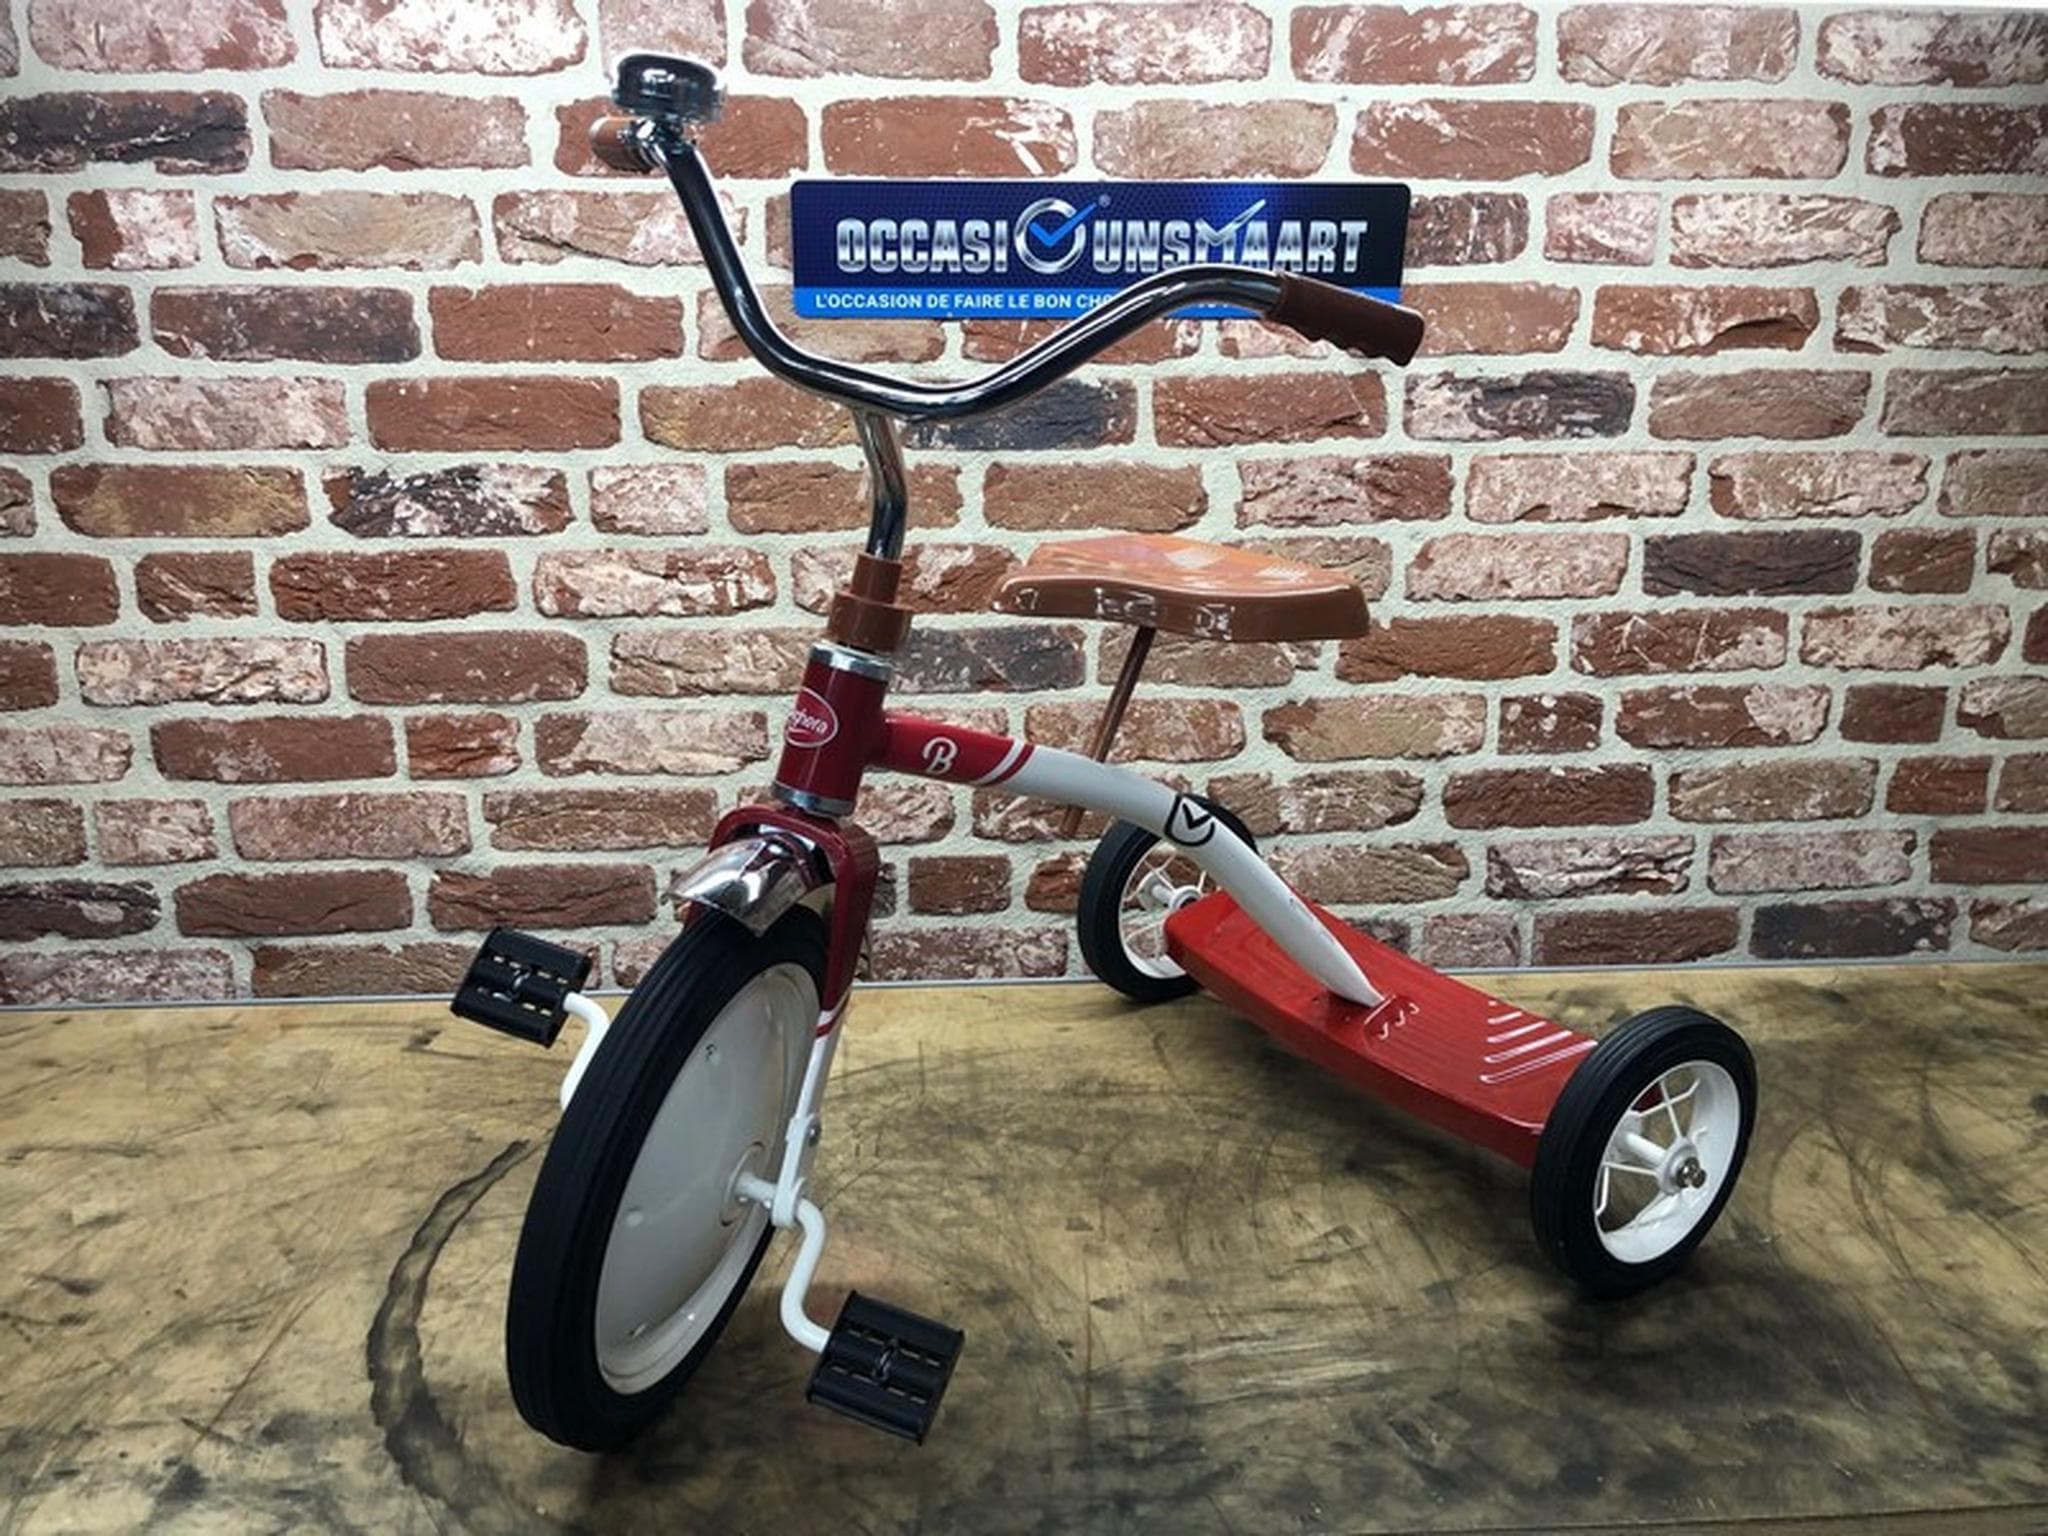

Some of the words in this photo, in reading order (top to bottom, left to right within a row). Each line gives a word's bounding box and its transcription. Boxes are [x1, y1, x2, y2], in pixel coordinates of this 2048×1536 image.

[815, 293, 922, 309] L'OCCASION
[926, 293, 950, 309] DE
[954, 293, 1003, 309] FAIRE
[1008, 293, 1030, 309] LE
[1034, 293, 1072, 309] BON
[922, 736, 959, 775] B
